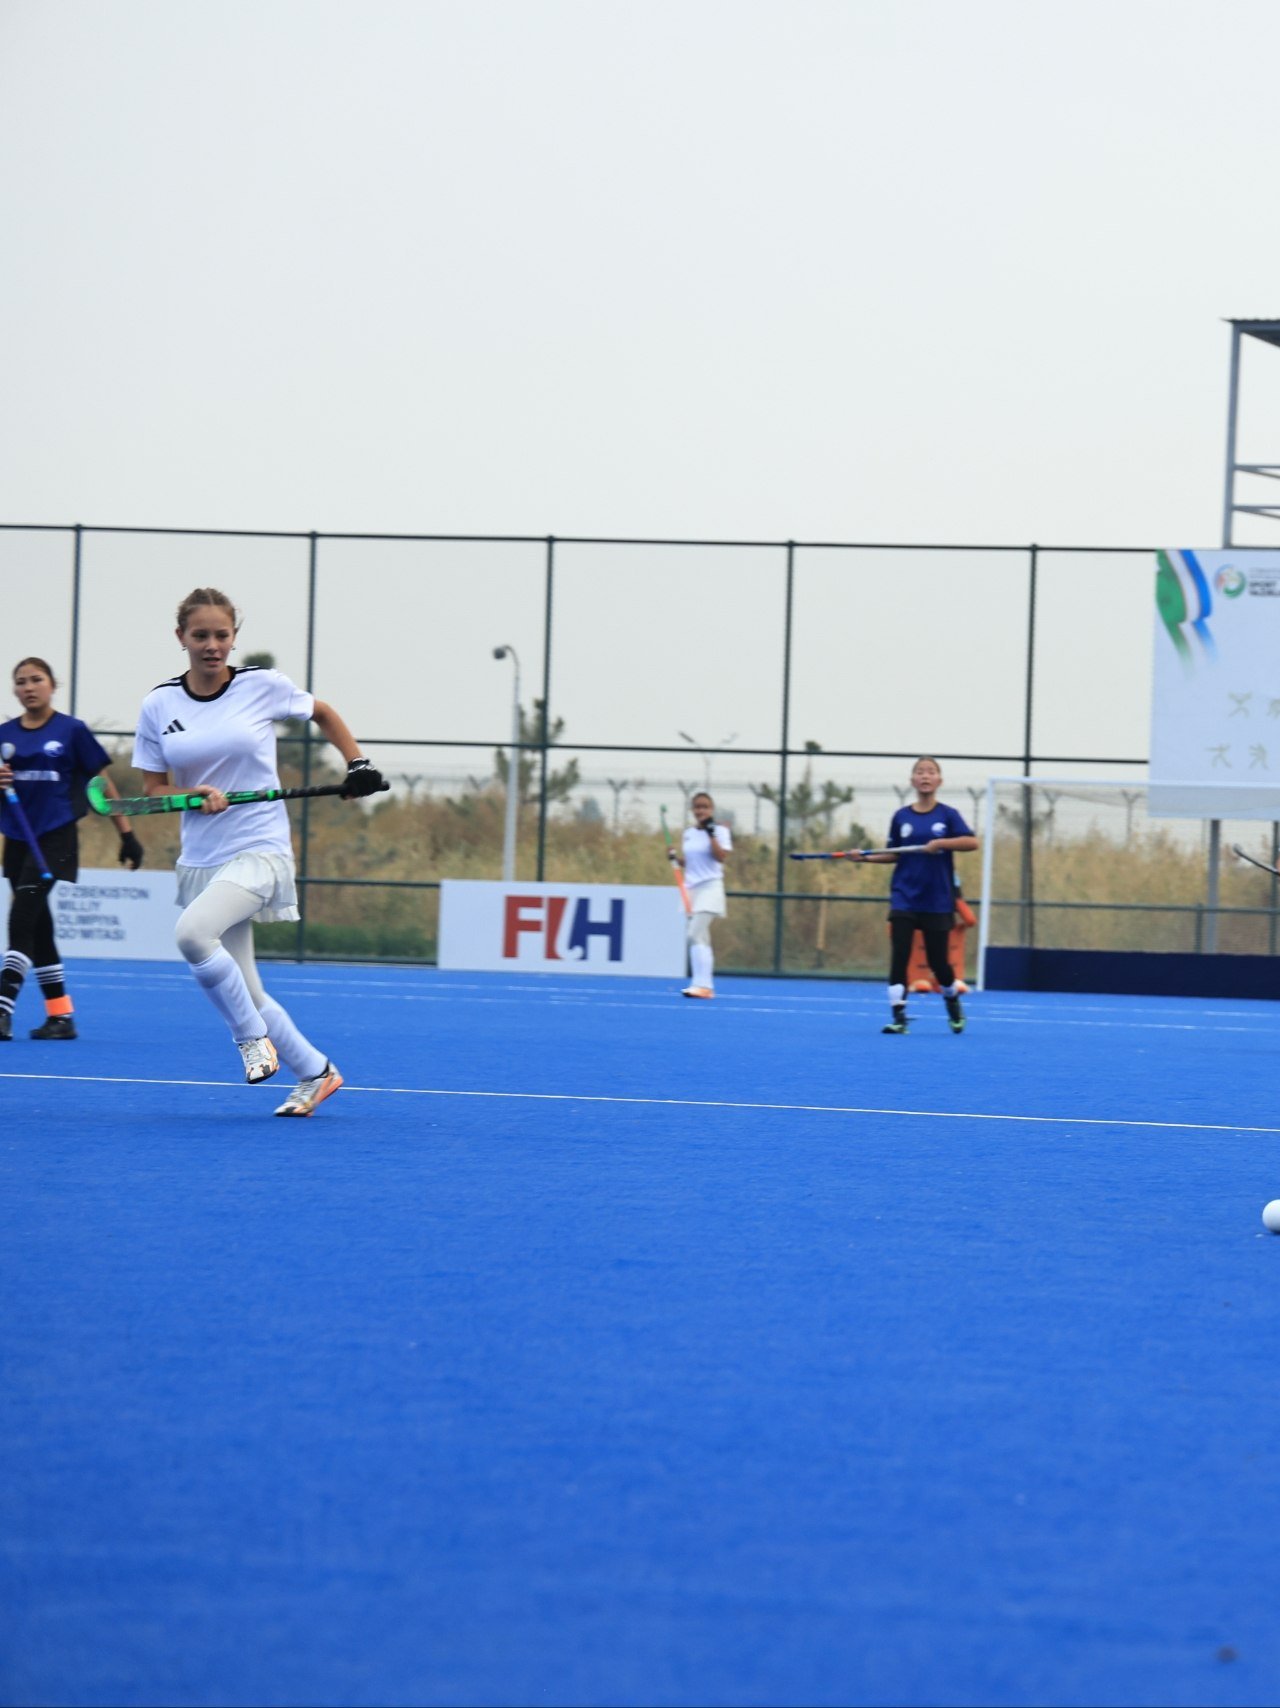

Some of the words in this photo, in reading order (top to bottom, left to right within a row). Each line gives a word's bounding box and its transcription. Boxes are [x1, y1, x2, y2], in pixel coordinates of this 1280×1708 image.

[57, 900, 101, 911] MILLIY
[56, 912, 120, 926] OLIMPIYA
[502, 895, 625, 961] FIH
